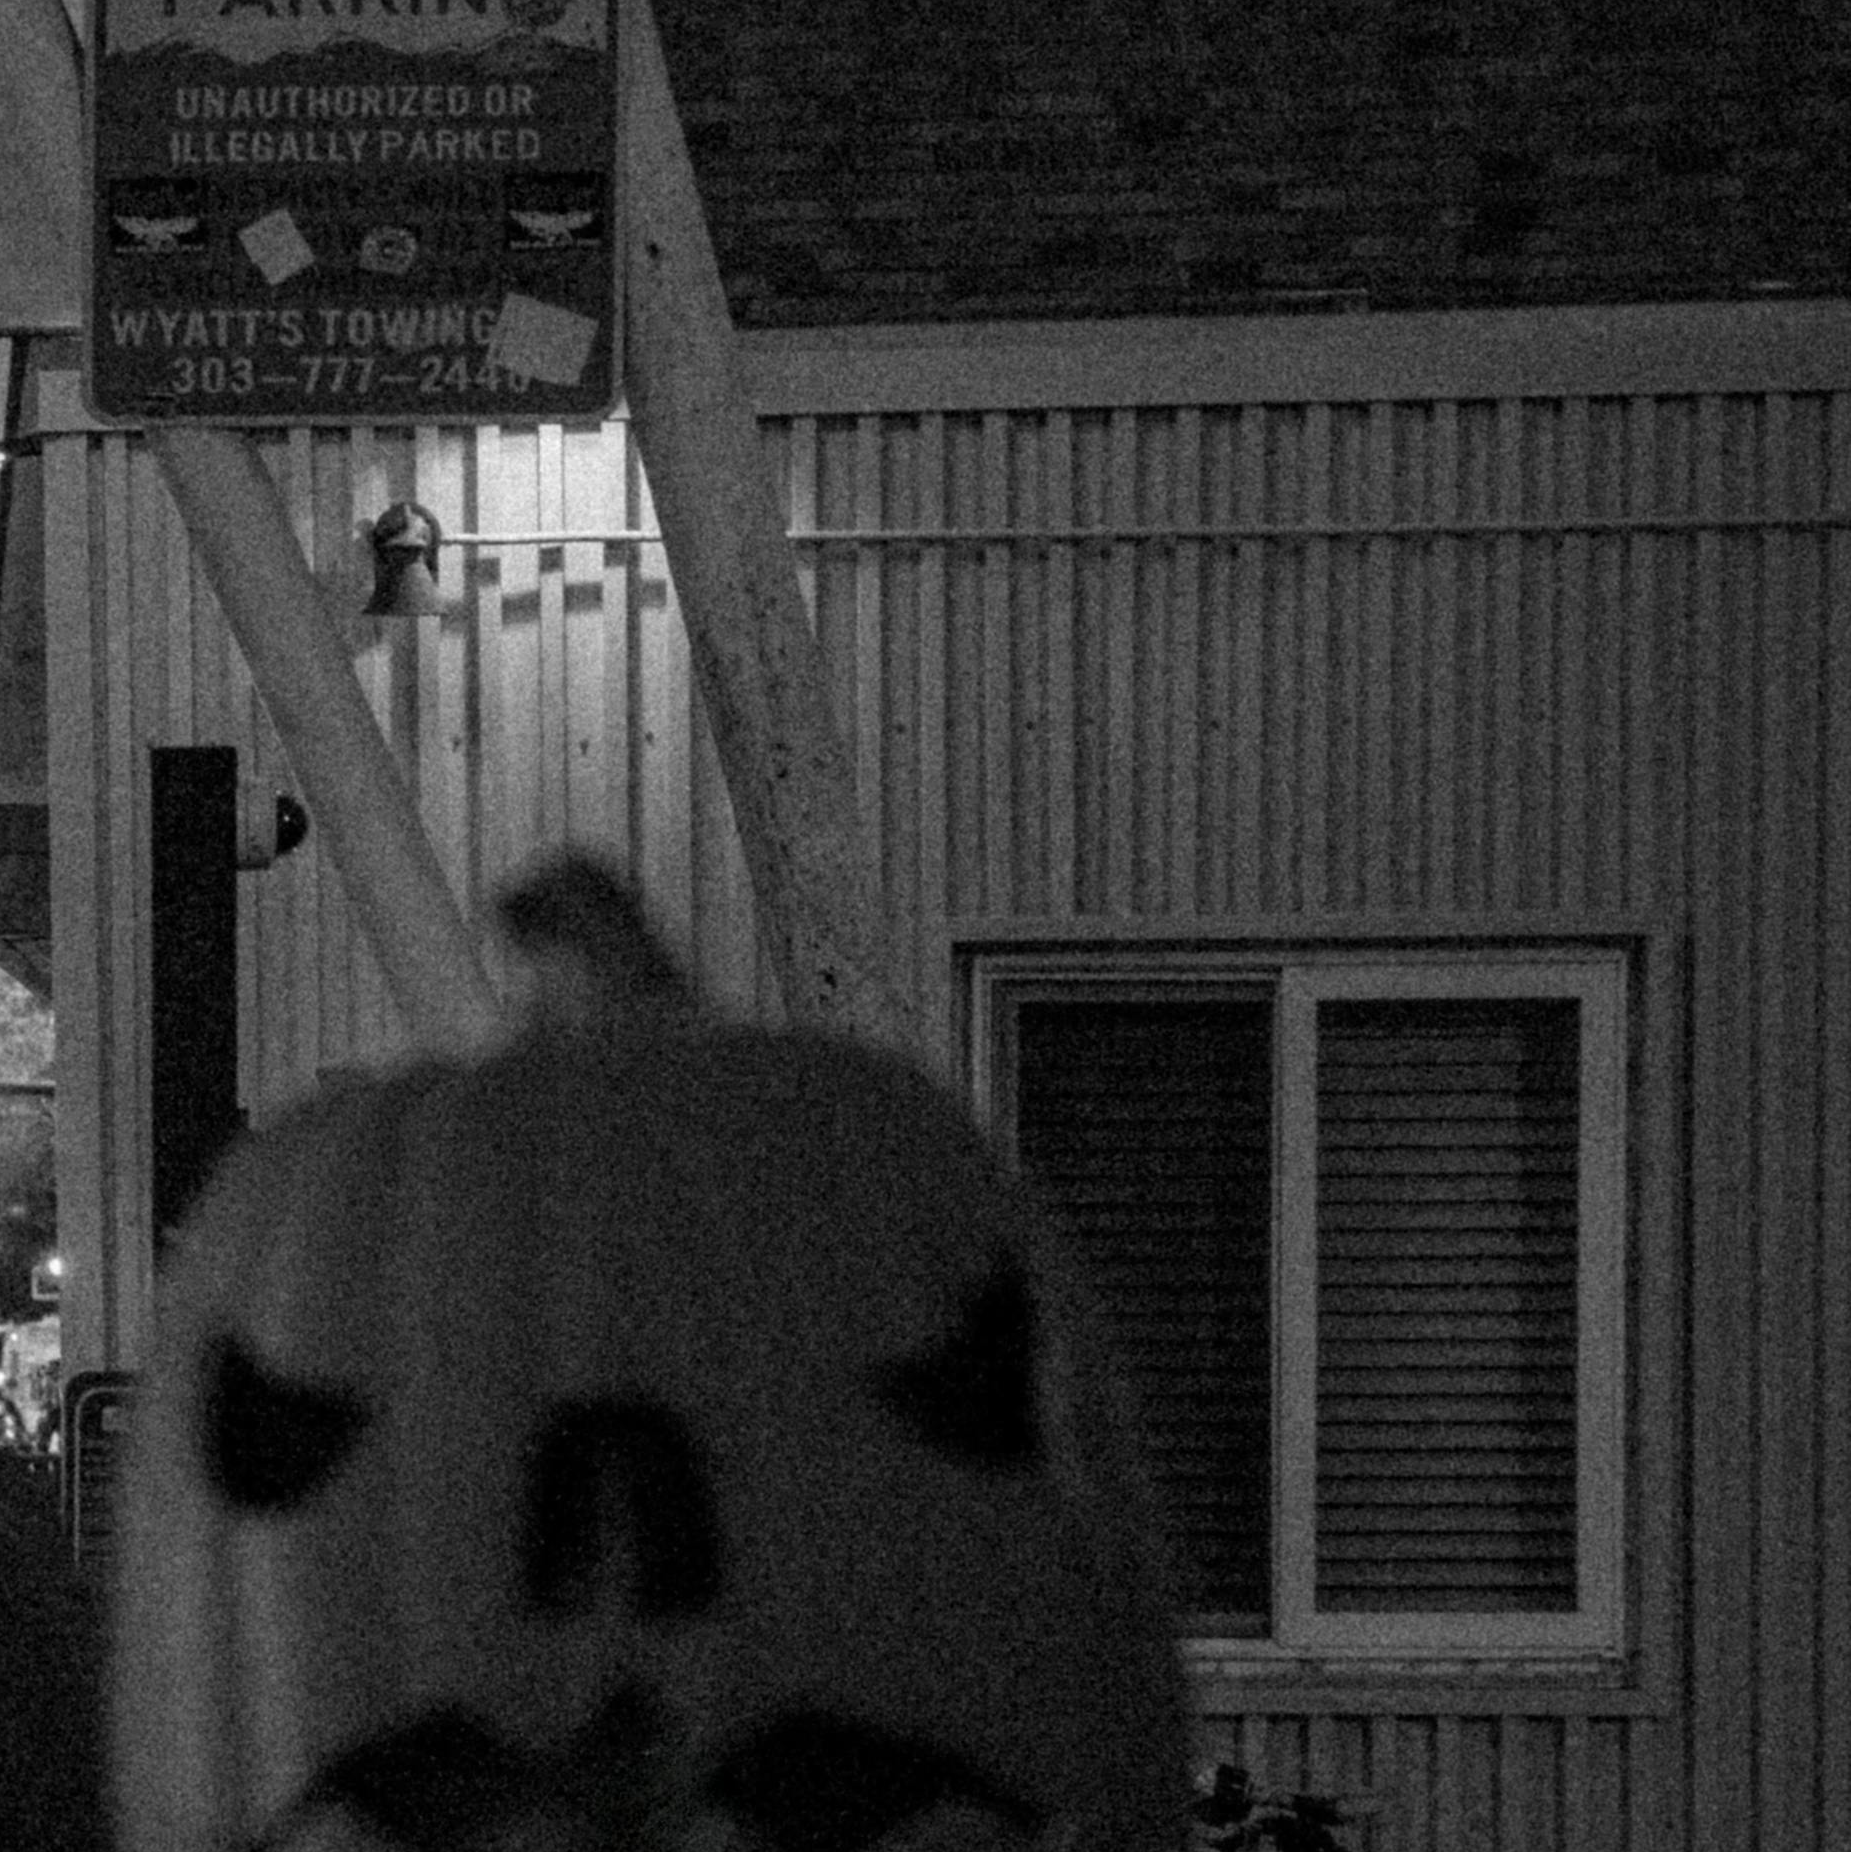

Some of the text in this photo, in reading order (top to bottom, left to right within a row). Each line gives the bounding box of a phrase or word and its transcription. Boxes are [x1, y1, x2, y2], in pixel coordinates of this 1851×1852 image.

[174, 84, 535, 120] UNAUTHORIZED OR
[169, 129, 542, 164] ILLEGALLY PARKED
[109, 307, 500, 349] WYATT'S TOWING
